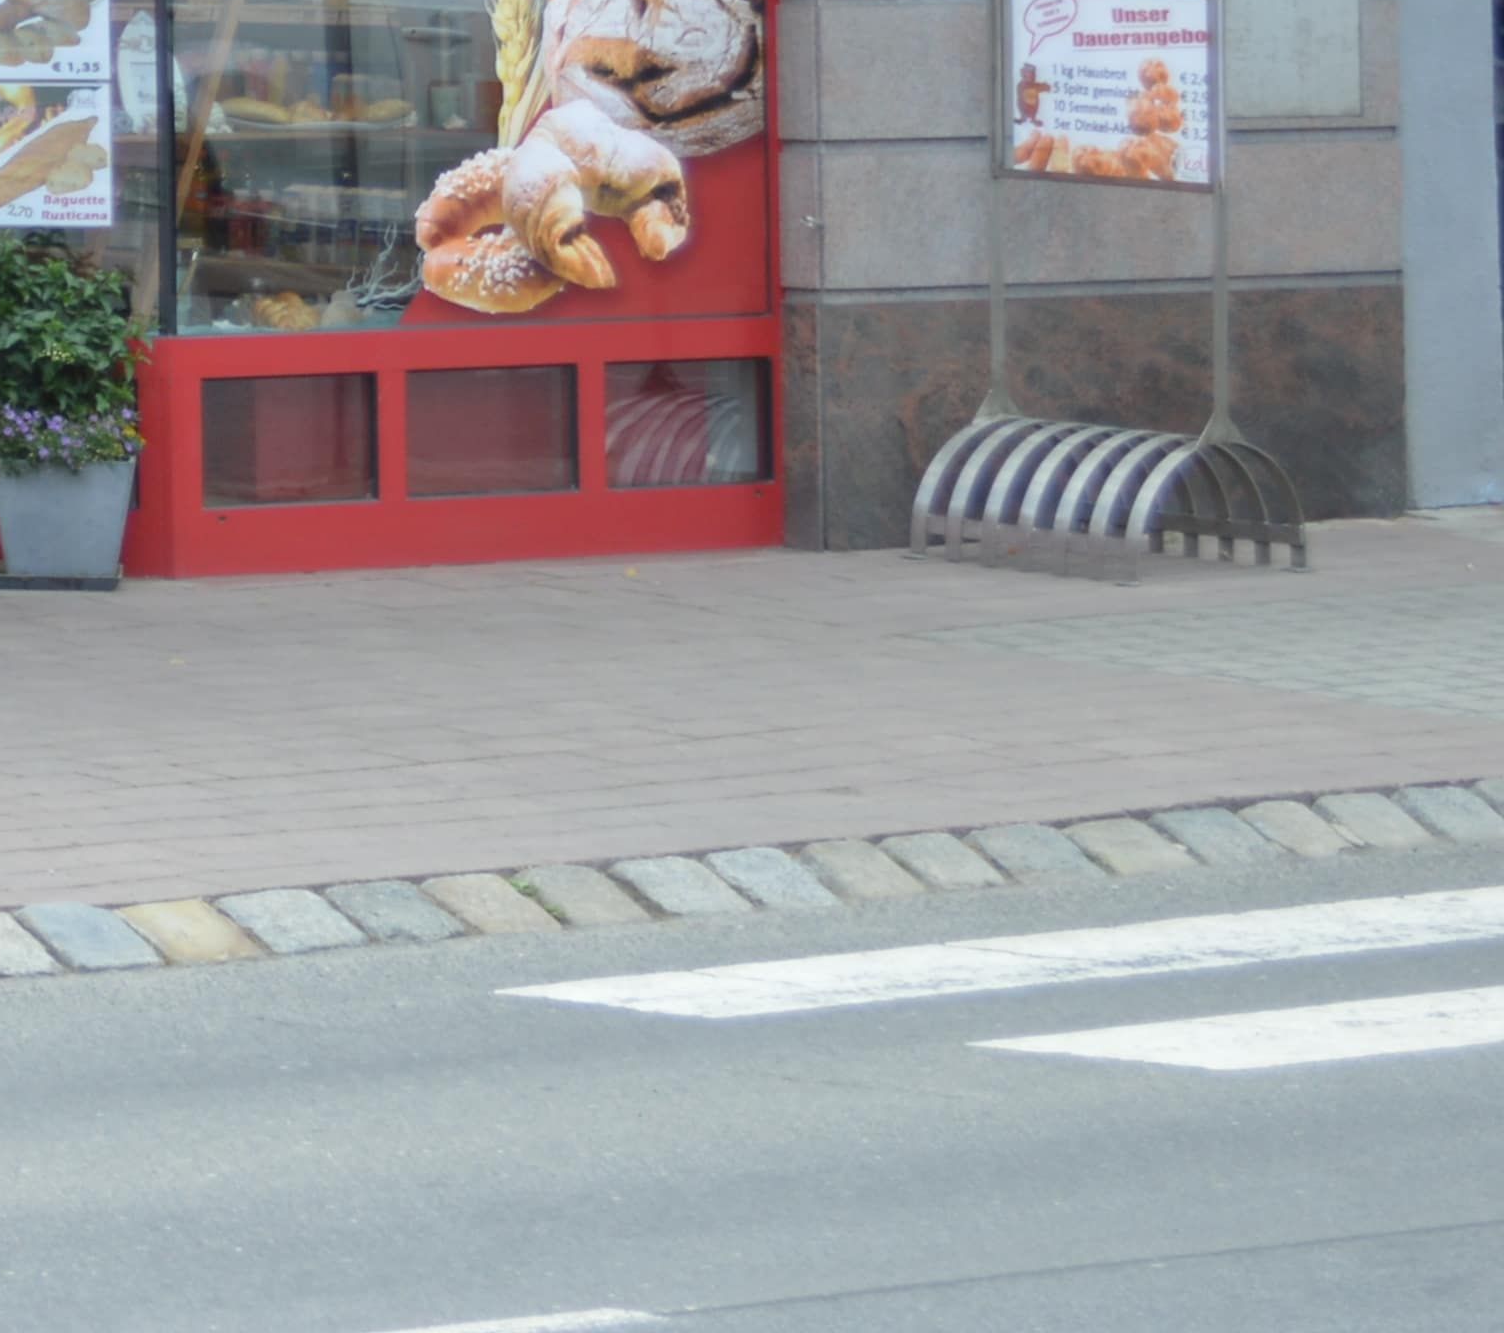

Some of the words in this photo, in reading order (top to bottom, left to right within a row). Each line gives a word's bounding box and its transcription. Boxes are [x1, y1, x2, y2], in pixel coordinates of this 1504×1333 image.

[1111, 8, 1170, 25] Unser
[1072, 29, 1213, 48] Dauerangebo
[1062, 65, 1074, 79] kg
[1053, 100, 1066, 112] 10
[43, 195, 106, 207] Baguette
[41, 210, 108, 221] Rusticana
